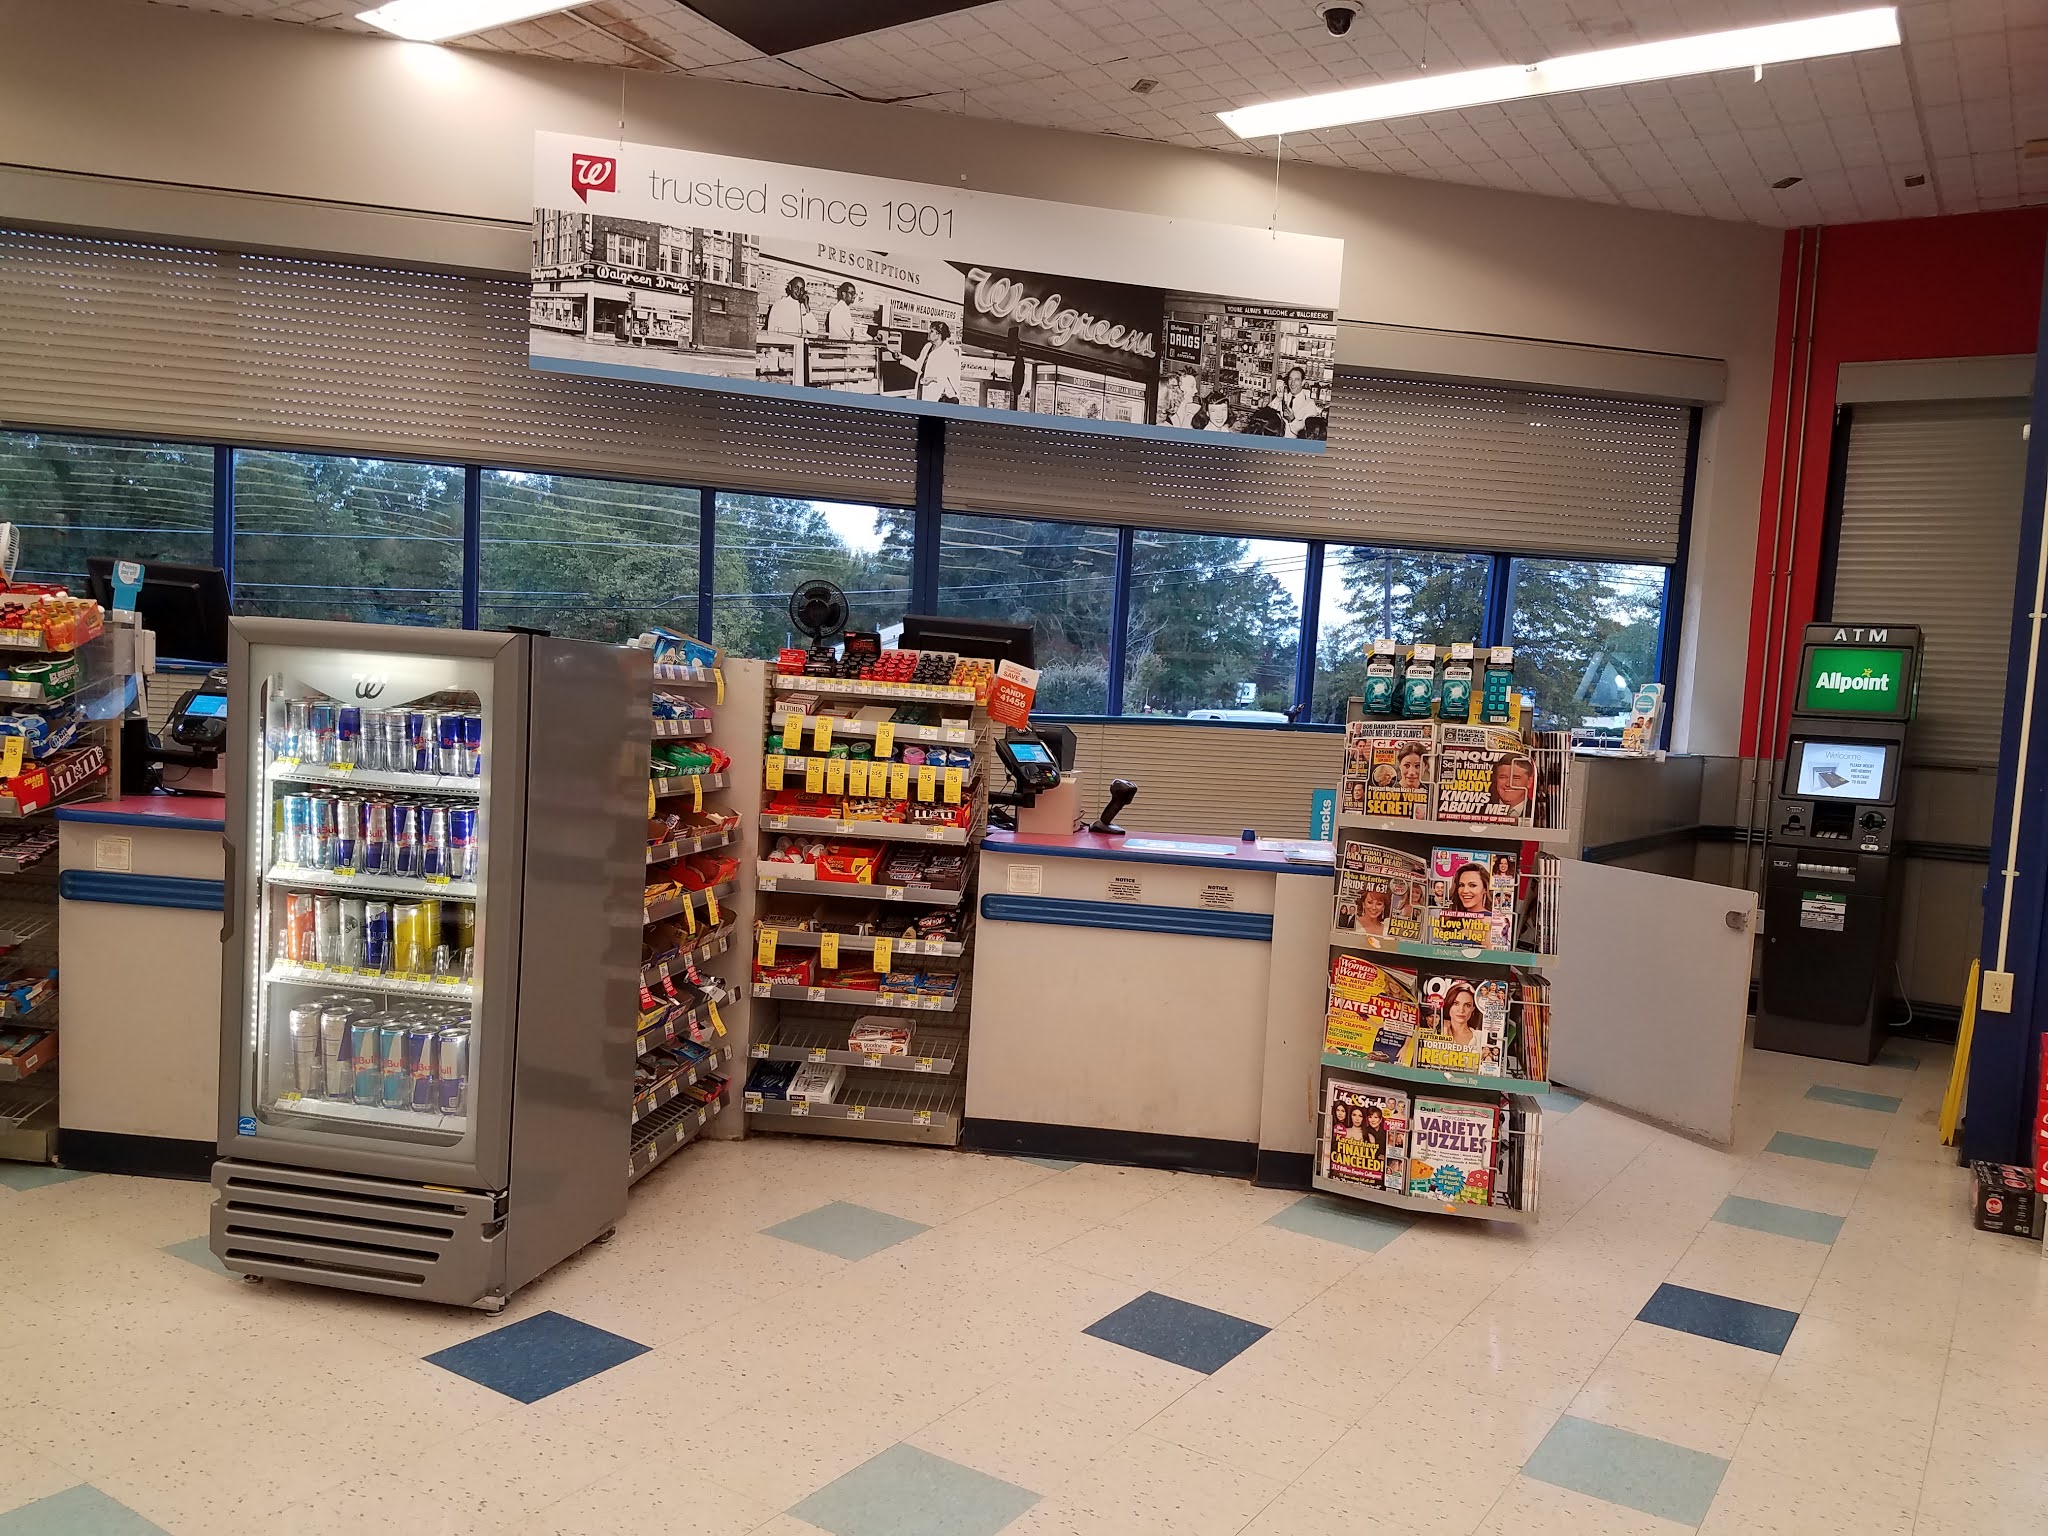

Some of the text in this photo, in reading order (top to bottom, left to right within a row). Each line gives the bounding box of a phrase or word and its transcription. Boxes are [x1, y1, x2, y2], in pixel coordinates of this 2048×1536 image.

[648, 170, 954, 239] trusted since 1901
[817, 243, 921, 285] PRESCRIPTIONS
[597, 266, 689, 293] Walgreen Drugs
[890, 299, 957, 320] VITAMIN HEADQUARTERS
[967, 267, 1156, 359] Walgreens
[1244, 307, 1261, 315] ALWAYS
[1263, 308, 1288, 317] WELCOME
[1297, 311, 1329, 319] WALGREENS
[1169, 333, 1200, 349] DRUGS
[1073, 377, 1091, 388] DRUGS
[1834, 628, 1888, 642] ATM
[1003, 671, 1020, 681] SAVE
[1815, 671, 1890, 693] Allpoint
[1000, 686, 1026, 699] CANDY
[1000, 694, 1026, 708] 41456
[779, 704, 804, 713] ALTOIDS
[50, 727, 68, 749] Orbit
[1361, 729, 1375, 737] MADE
[1383, 730, 1393, 738] HIS
[1392, 730, 1402, 738] SEX
[1403, 730, 1422, 739] SLAVE!
[1825, 751, 1862, 760] Welcome
[1464, 761, 1494, 771] Hannity
[24, 773, 44, 786] SHARE
[1456, 768, 1493, 781] WHAT
[31, 780, 44, 790] SIZE
[1441, 779, 1492, 793] NOBODY
[1368, 791, 1371, 800] I
[1373, 791, 1400, 801] KNOW
[1401, 792, 1428, 802] YOUR
[1440, 790, 1492, 803] KNOWS
[1367, 799, 1413, 816] SECRET!
[1439, 801, 1511, 816] ABOUT ME!
[1360, 849, 1381, 857] MICHAEL
[1346, 852, 1403, 868] BACK FROM DEAD!
[1360, 874, 1389, 884] McEntire:
[1342, 878, 1388, 894] BRIDE AT 63!
[1390, 918, 1420, 930] BRIDE
[1431, 916, 1490, 931] In Love With a
[1388, 927, 1419, 938] AT 67!
[1432, 927, 1486, 941] Regular Joe!
[1341, 958, 1378, 974] Woman's
[1339, 966, 1367, 980] World
[762, 976, 800, 985] Skittles
[1348, 982, 1366, 990] RELIEF
[1334, 996, 1416, 1025] WATER CURE
[1371, 996, 1417, 1014] The NEW
[1330, 1018, 1372, 1031] STOP CRAVINGS
[1328, 1031, 1357, 1041] DISCOVERY
[1329, 1026, 1363, 1038] AUTOIMMUNE
[863, 1042, 888, 1051] goodness
[1326, 1039, 1350, 1048] REGROW
[1422, 1040, 1474, 1053] TORTURED BY
[1421, 1047, 1480, 1069] REGRET!
[1468, 1078, 1478, 1086] Day
[1420, 1116, 1487, 1137] VARIETY
[1336, 1134, 1380, 1149] Kardashians
[1416, 1132, 1487, 1153] PUZZLES
[1337, 1142, 1378, 1160] FINALLY
[1331, 1151, 1385, 1173] CANCELED!
[1351, 1168, 1364, 1176] Empire
